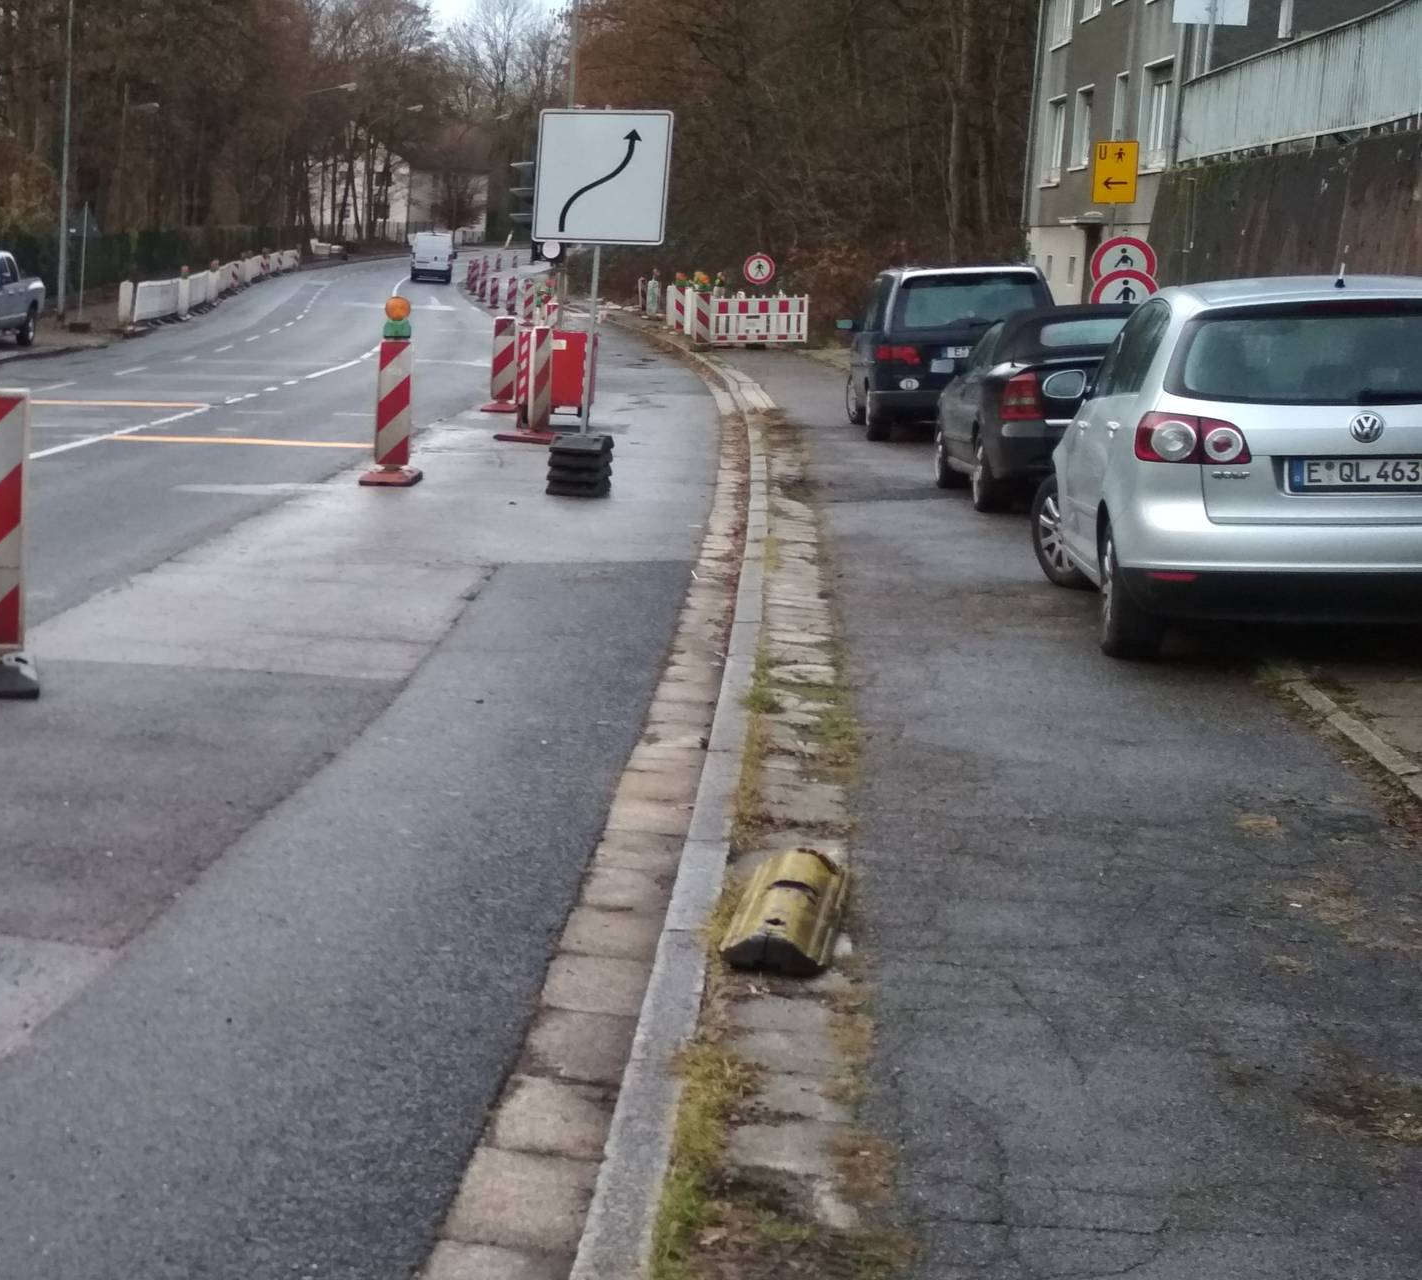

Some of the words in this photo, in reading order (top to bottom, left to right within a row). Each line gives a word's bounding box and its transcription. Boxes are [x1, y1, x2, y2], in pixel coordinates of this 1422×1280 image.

[1099, 145, 1107, 160] U
[1307, 462, 1322, 483] E
[1339, 462, 1371, 482] QL
